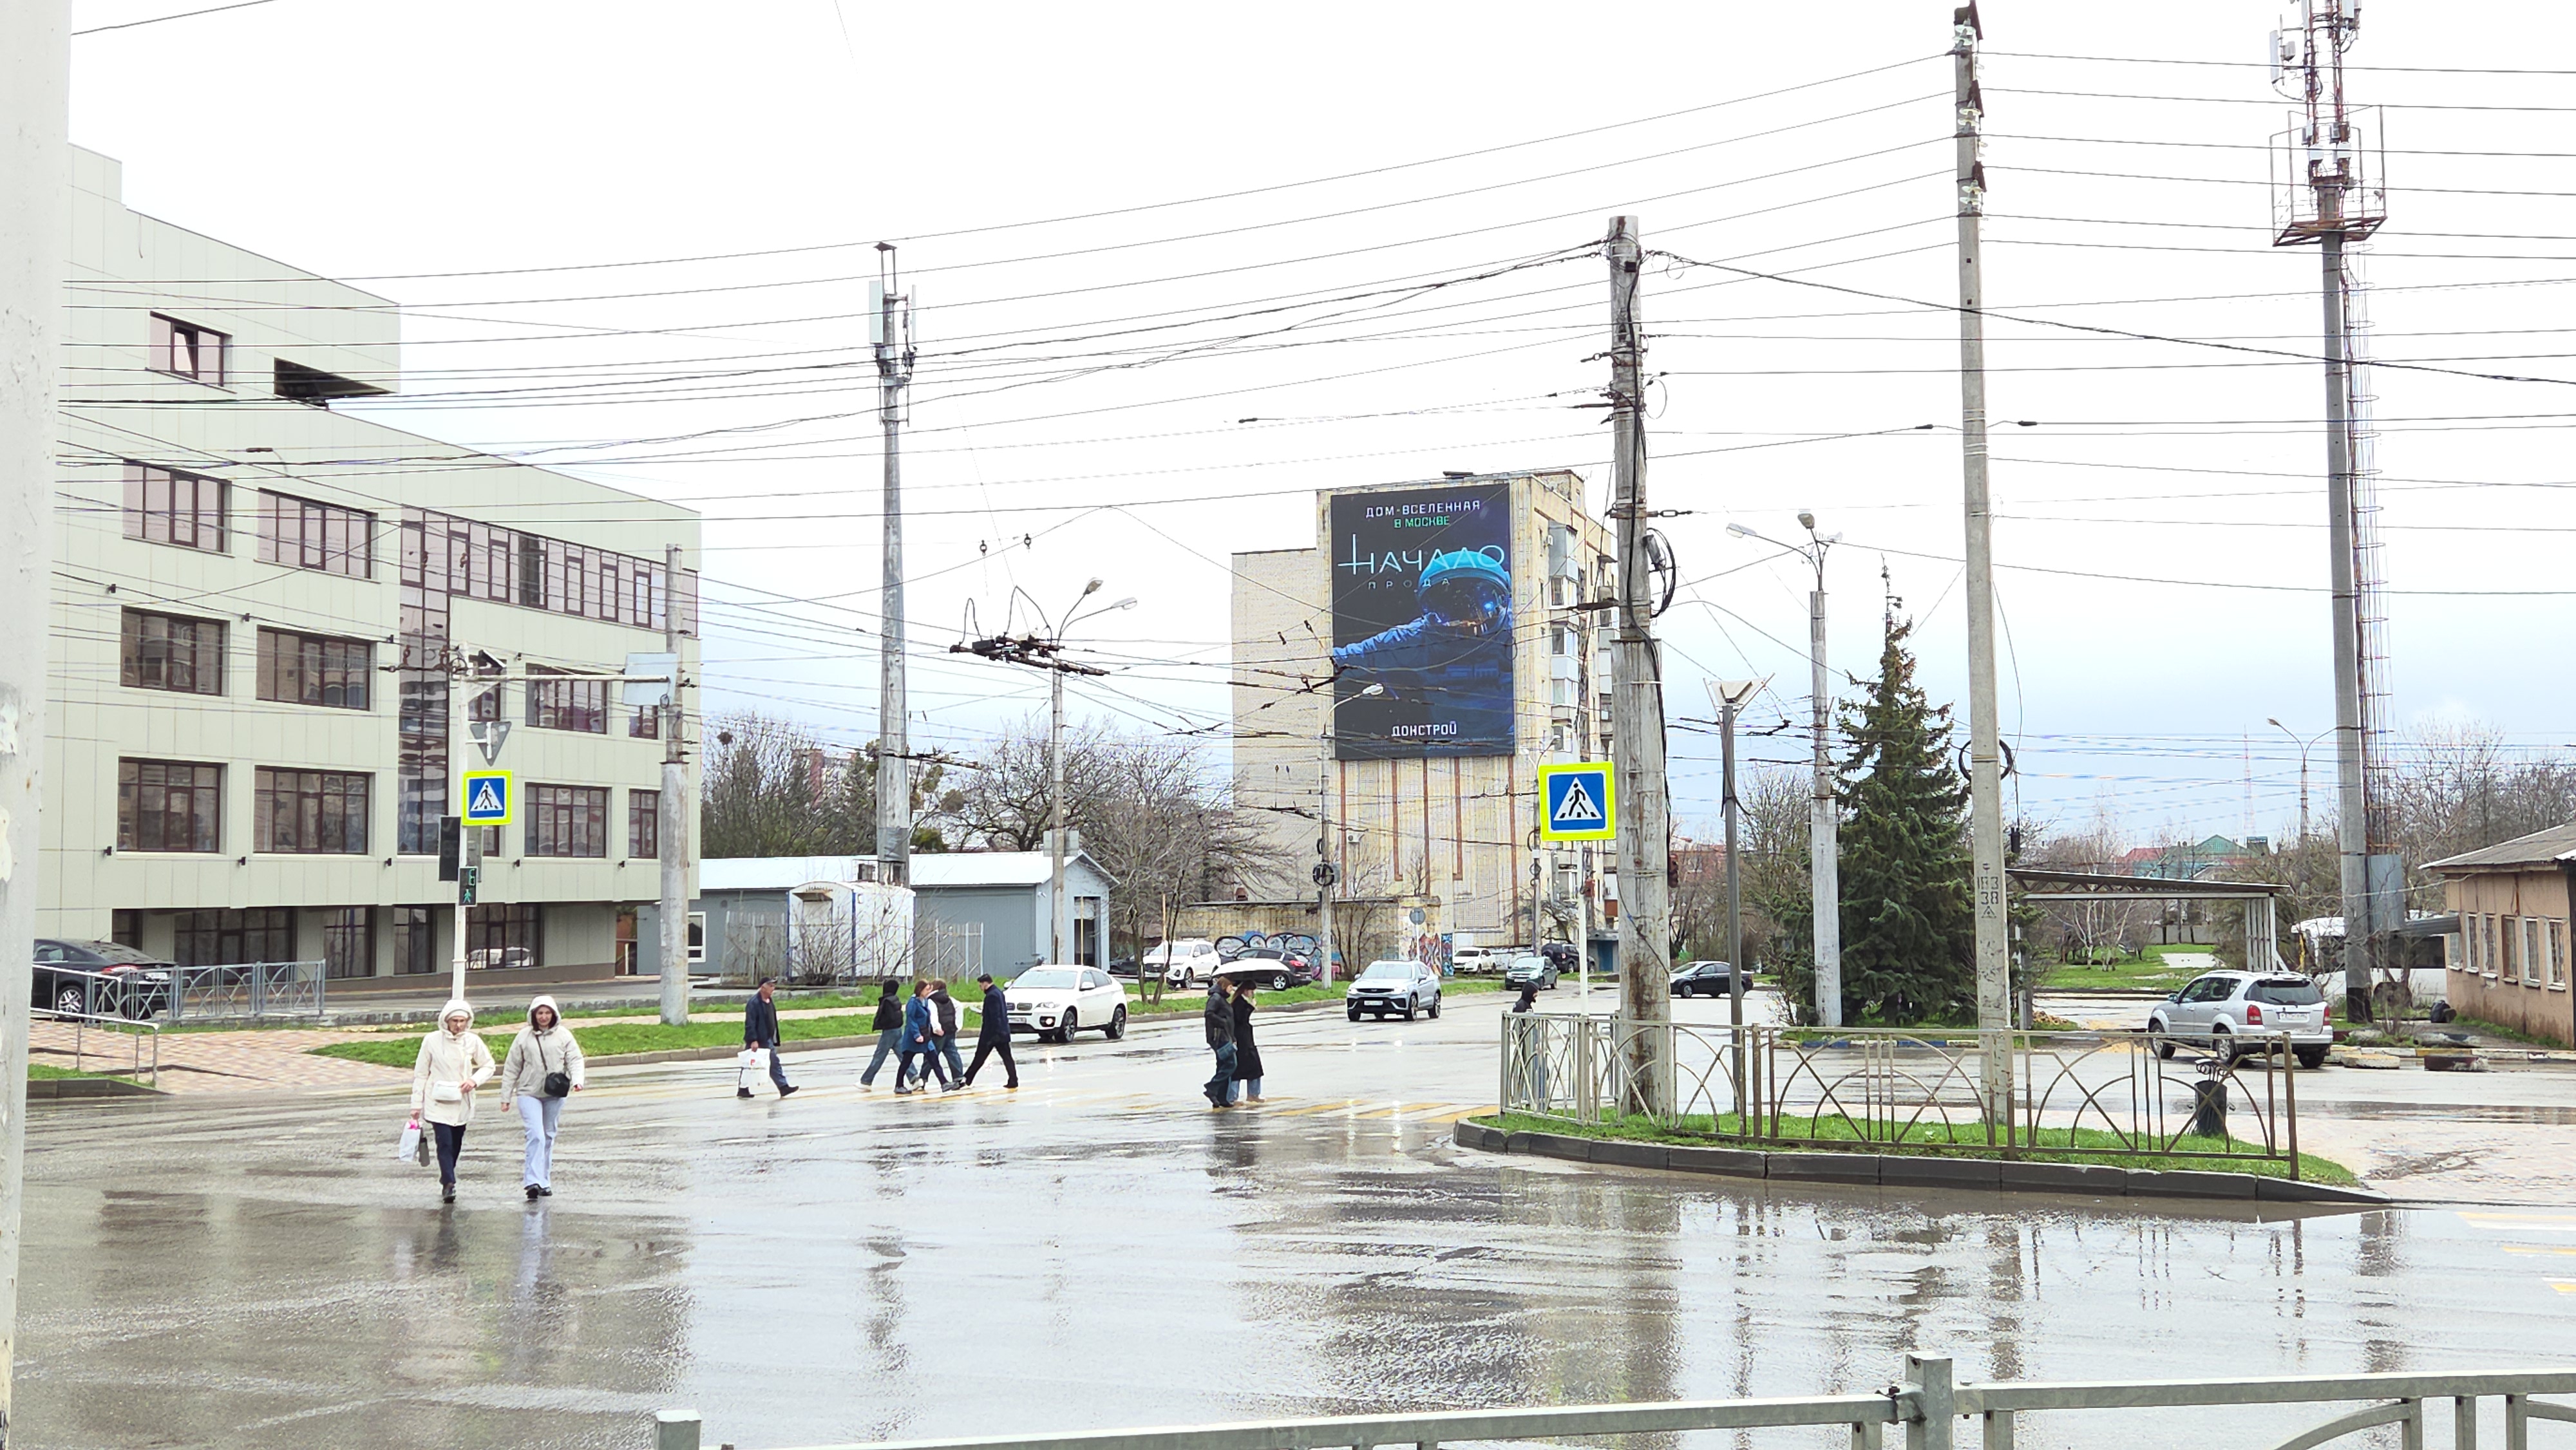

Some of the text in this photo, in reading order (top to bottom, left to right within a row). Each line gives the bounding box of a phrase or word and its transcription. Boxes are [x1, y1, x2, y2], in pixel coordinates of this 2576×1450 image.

[1365, 500, 1481, 518] ДОМ-ВСЕЛЕННАЯ
[1394, 516, 1450, 528] В МОСКВЕ
[1338, 534, 1504, 575] НАЧАЛО
[1391, 720, 1457, 737] ДОНСТРОЙ
[1980, 891, 1999, 905] 38
